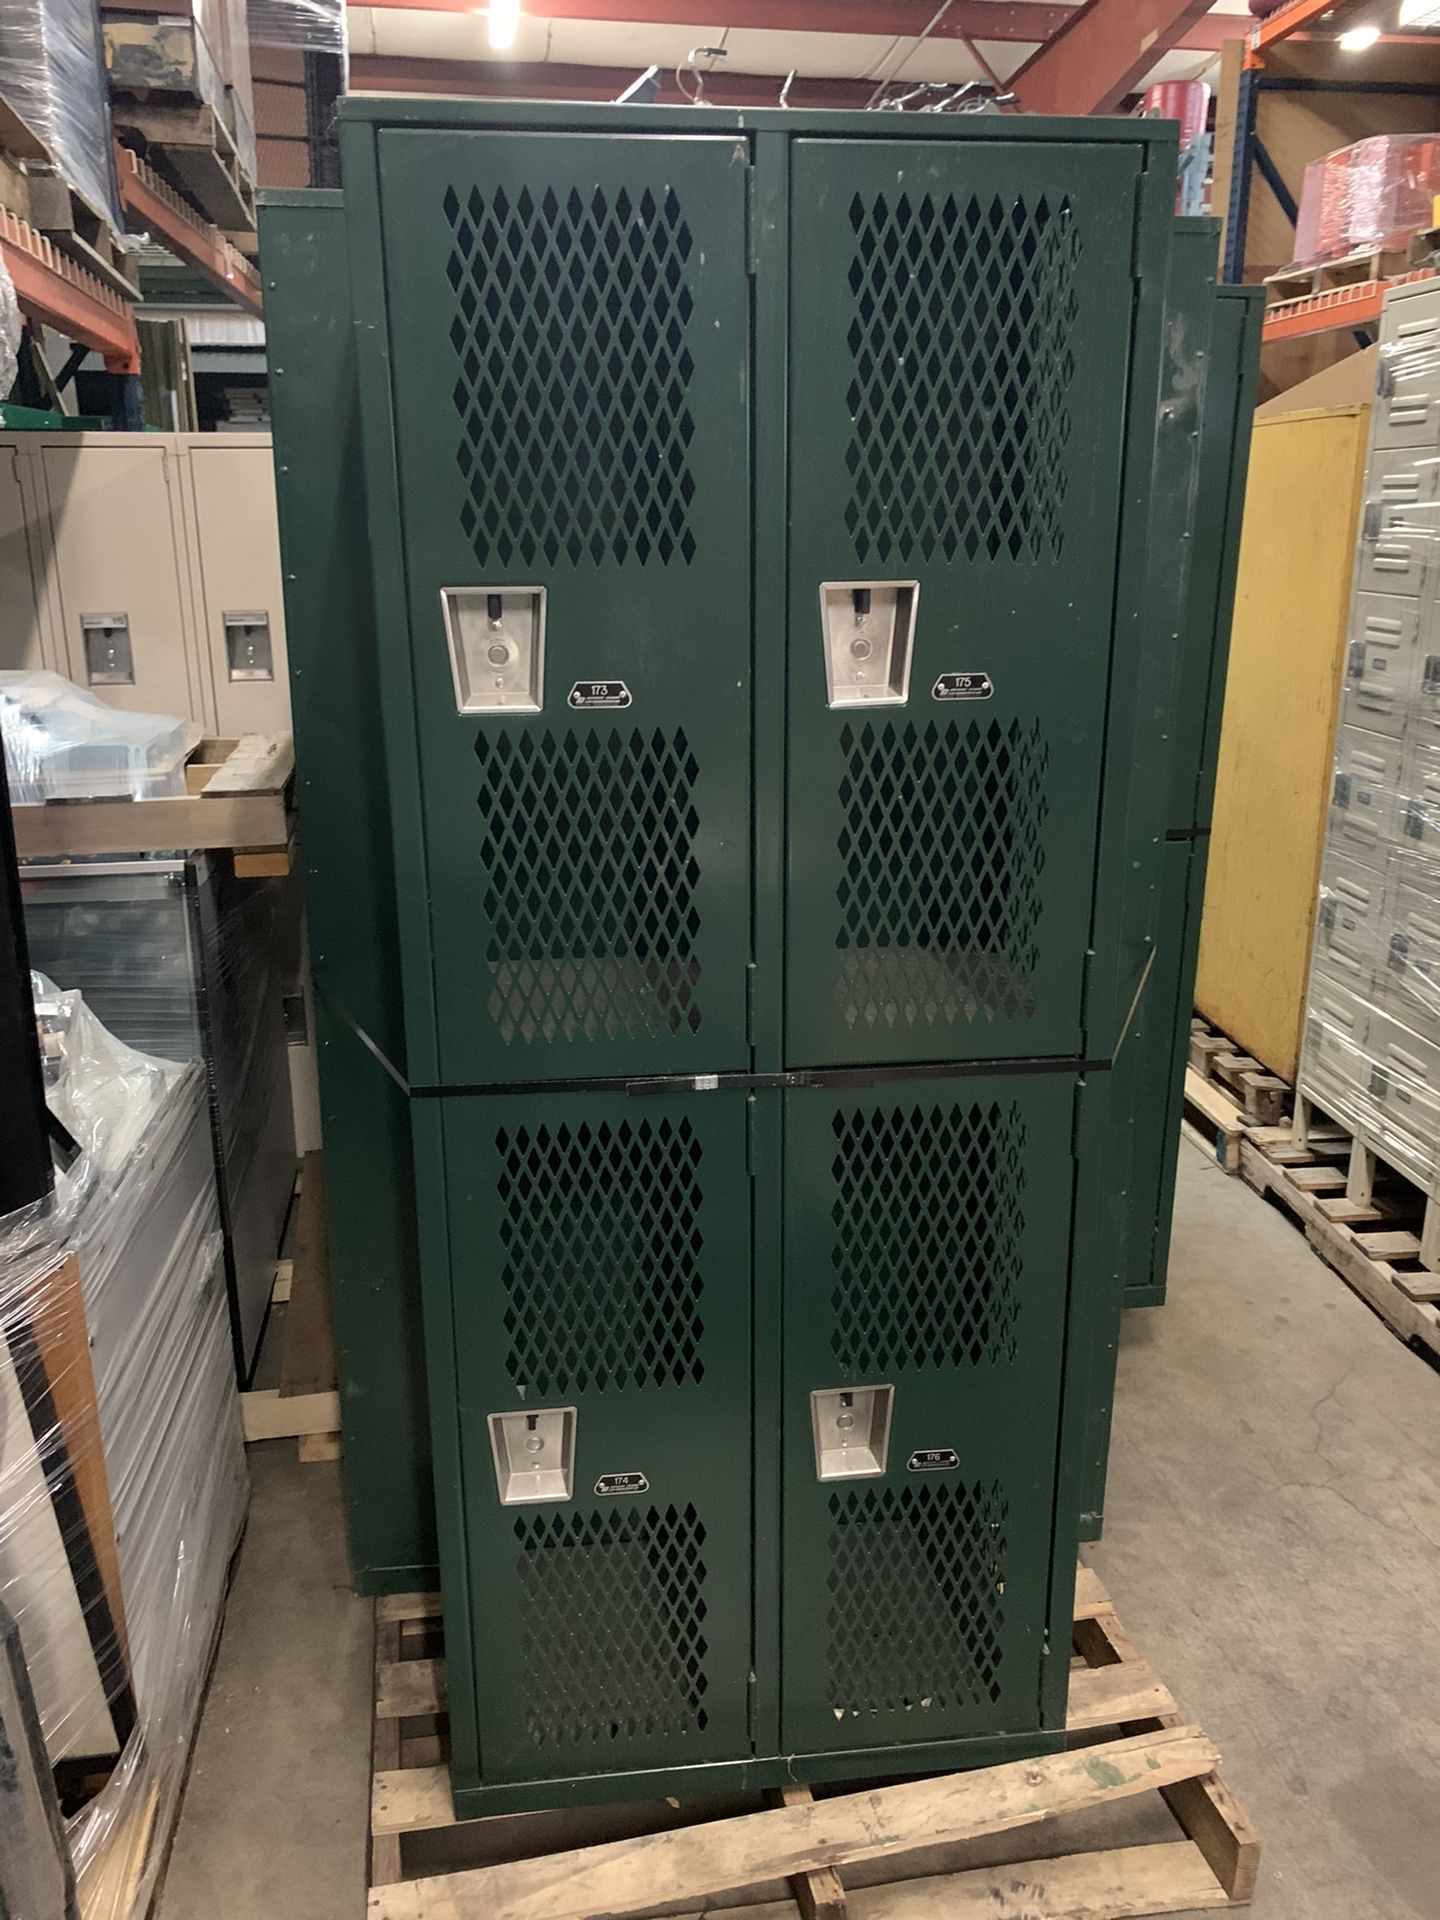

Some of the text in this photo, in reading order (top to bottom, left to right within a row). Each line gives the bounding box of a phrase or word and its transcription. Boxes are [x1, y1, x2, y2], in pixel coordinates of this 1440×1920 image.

[955, 677, 972, 687] 175
[591, 685, 608, 695] 173
[927, 1453, 940, 1461] 176
[614, 1476, 628, 1485] 174
